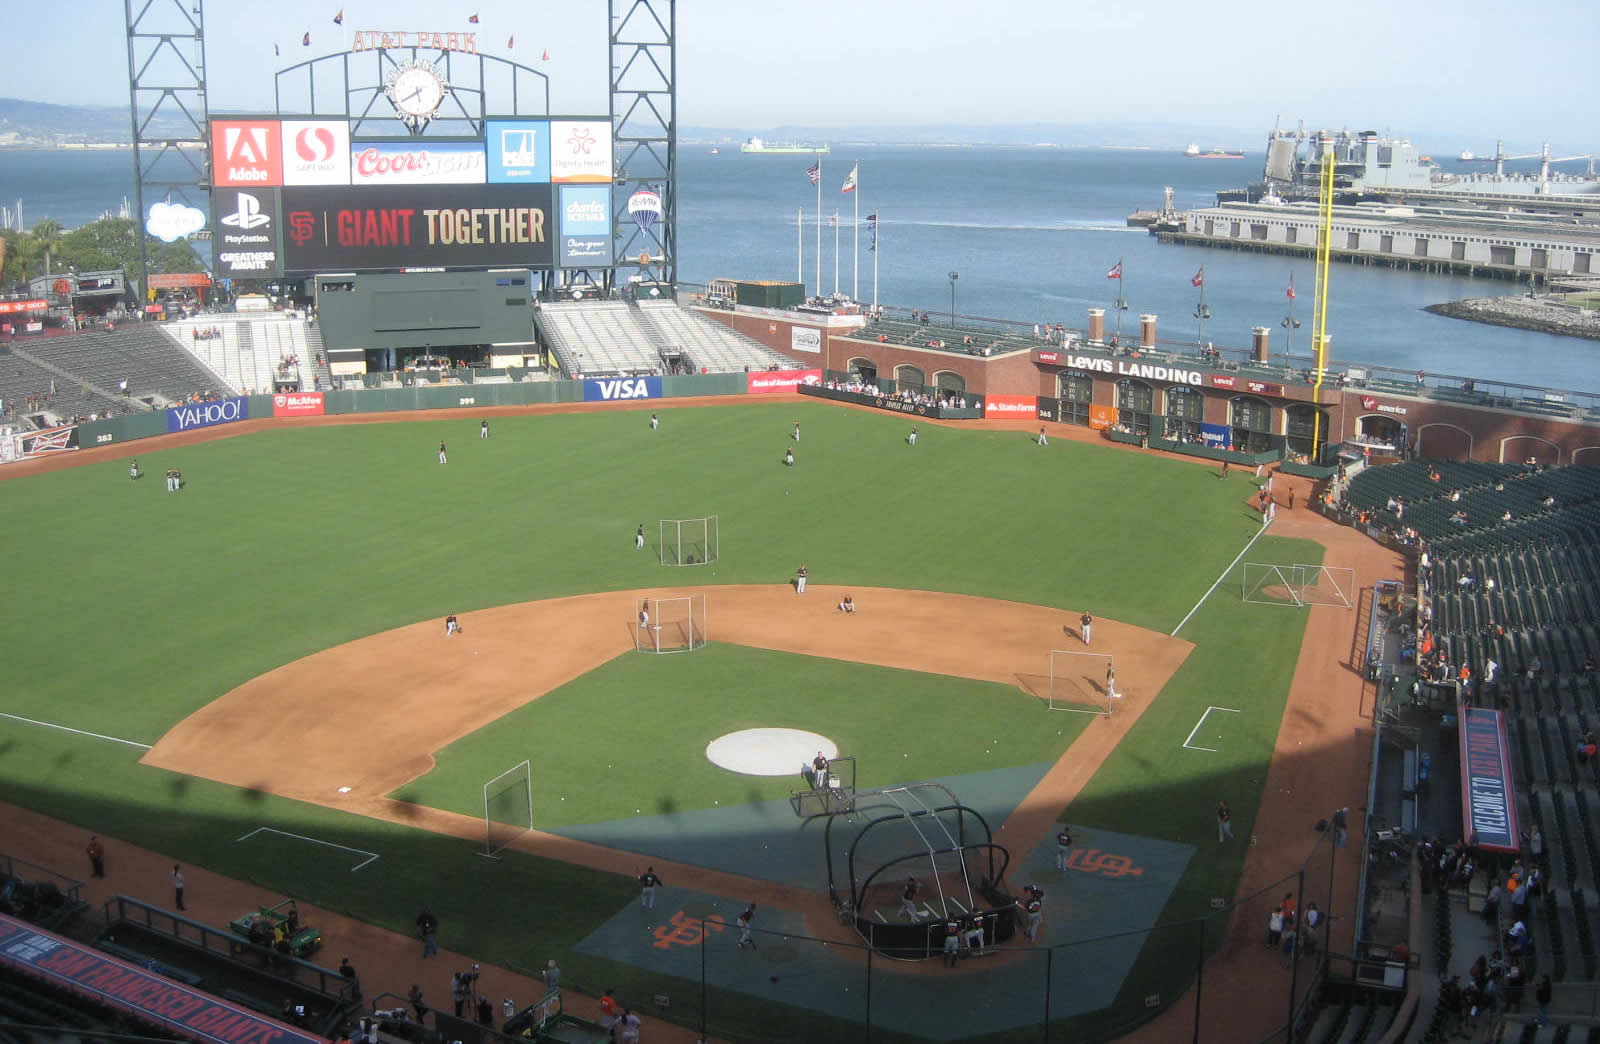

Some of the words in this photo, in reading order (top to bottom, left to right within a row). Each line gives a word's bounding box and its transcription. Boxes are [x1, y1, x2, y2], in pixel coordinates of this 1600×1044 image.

[352, 31, 408, 53] AT&T
[416, 31, 478, 55] PARK
[395, 110, 440, 127] GIANTS
[228, 167, 268, 181] Adobe
[337, 209, 414, 247] GIANT
[423, 208, 545, 245] TOGETHER
[225, 235, 269, 244] PlayStation
[220, 252, 275, 262] GREATNESS
[1118, 361, 1202, 386] LANDING
[595, 379, 648, 400] VISA
[288, 396, 321, 406] McAfee
[175, 399, 241, 430] YAHOO!
[1471, 776, 1502, 790] TO
[1473, 791, 1507, 835] WELCOME
